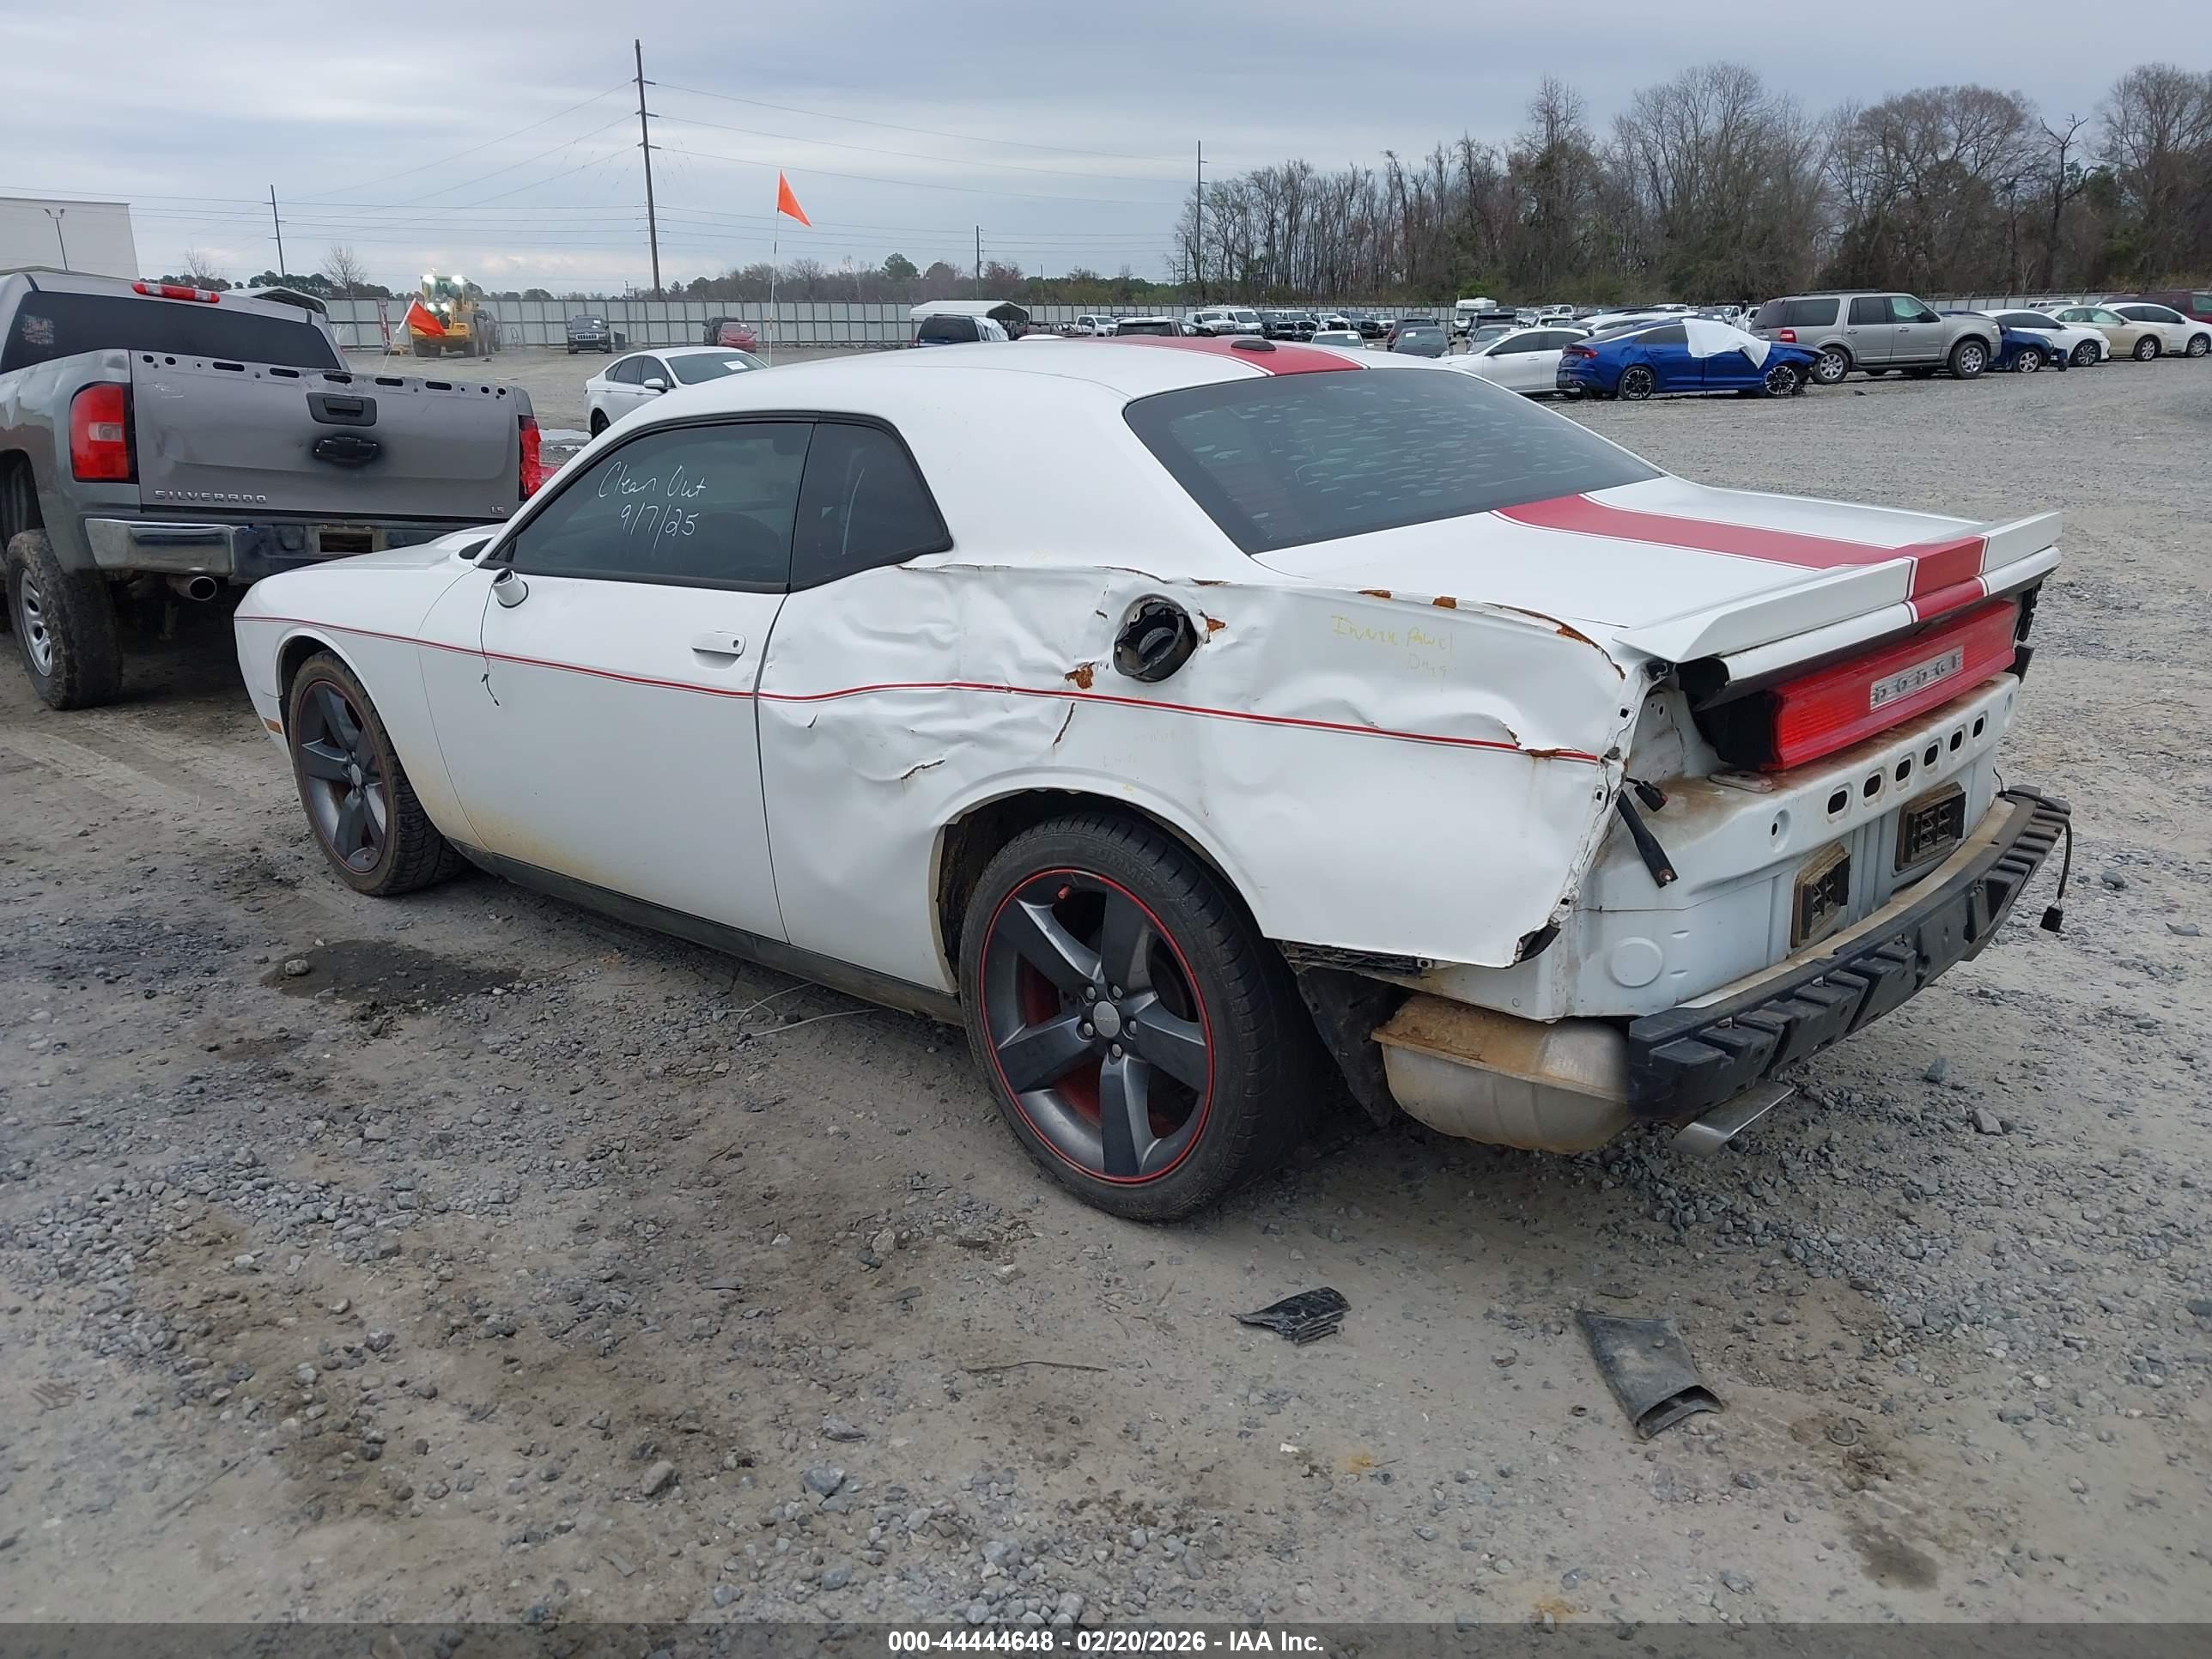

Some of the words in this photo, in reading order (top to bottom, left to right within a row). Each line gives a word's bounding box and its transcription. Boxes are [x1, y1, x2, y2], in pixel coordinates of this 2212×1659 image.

[155, 489, 267, 504] SILVERADO
[599, 460, 657, 497] Clean
[667, 465, 706, 497] Out
[620, 501, 700, 550] 9/7/25
[1873, 650, 1962, 703] DODGE
